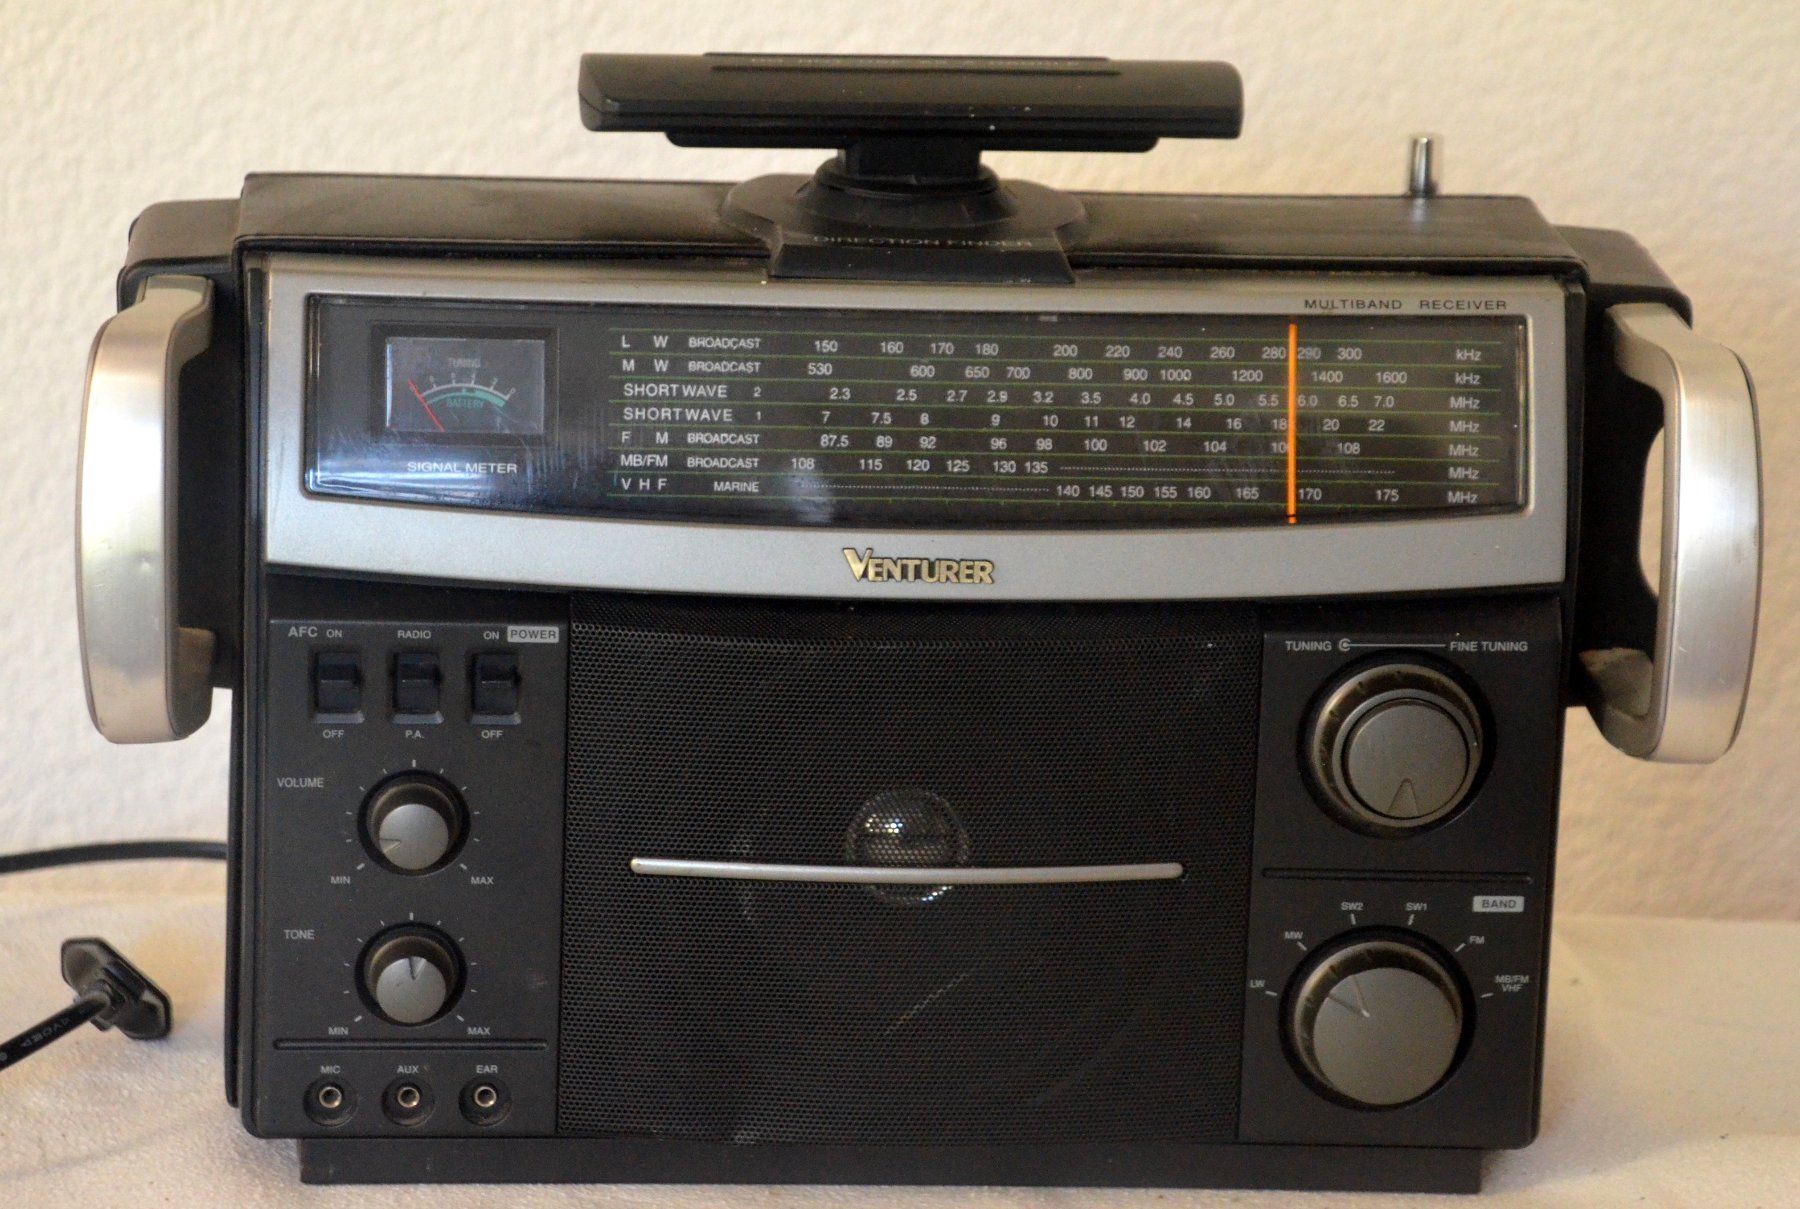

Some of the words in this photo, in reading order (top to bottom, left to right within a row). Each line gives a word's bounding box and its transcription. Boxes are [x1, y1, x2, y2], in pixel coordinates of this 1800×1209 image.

[1304, 299, 1402, 309] MULTIBAND
[1420, 300, 1507, 310] RECEIVER
[688, 337, 761, 349] BROADCAST
[815, 340, 838, 352] 150
[880, 342, 904, 353] 160
[931, 342, 954, 354] 170
[975, 343, 999, 356] 180
[1053, 344, 1078, 357] 200
[1105, 345, 1130, 358] 220
[1157, 346, 1183, 358] 240
[1210, 347, 1235, 359] 260
[1262, 347, 1286, 359] 280
[1337, 348, 1362, 360] 300
[1456, 349, 1482, 361] kHz
[688, 361, 761, 373] BROADCAST
[808, 362, 832, 375] 530
[910, 365, 935, 377] 600
[965, 366, 990, 378] 650
[1006, 366, 1031, 379] 700
[1068, 368, 1093, 380] 800
[1123, 368, 1148, 381] 900
[1160, 369, 1192, 381] 1000
[1232, 370, 1263, 382] 1200
[1311, 371, 1343, 383] 1400
[1376, 371, 1407, 384] 1600
[1455, 372, 1480, 385] kHz
[753, 387, 762, 397] 2
[830, 387, 851, 400] 2.3
[896, 389, 917, 401] 2.5
[947, 390, 968, 402] 2.7
[1032, 391, 1054, 403] 3.2
[1081, 392, 1101, 404] 3.5
[1130, 393, 1151, 405] 4.0
[1173, 393, 1194, 405] 4.5
[1214, 394, 1235, 406] 5.0
[1258, 394, 1279, 406] 5.5
[1338, 395, 1359, 407] 6.5
[1374, 396, 1394, 407] 7.0
[1450, 396, 1480, 409] MHz
[822, 411, 831, 424] 7
[871, 412, 892, 424] 7.5
[991, 414, 1001, 426] 9
[1043, 415, 1059, 427] 10
[1084, 416, 1099, 427] 11
[1119, 416, 1135, 428] 12
[1176, 417, 1192, 429] 14
[1226, 418, 1242, 430] 16
[1323, 419, 1340, 431] 20
[1368, 419, 1385, 431] 22
[1450, 421, 1480, 433] MHz
[687, 433, 760, 445] BROADCAST
[820, 434, 849, 447] 87.5
[876, 435, 893, 448] 89
[919, 436, 936, 449] 92
[990, 438, 1007, 450] 96
[1036, 438, 1052, 450] 98
[1084, 439, 1108, 451] 100
[1143, 440, 1167, 452] 102
[1203, 441, 1227, 452] 104
[1271, 441, 1290, 453] 10
[1336, 442, 1360, 454] 108
[1449, 444, 1479, 457] MHz
[407, 461, 461, 472] SIGNAL
[465, 463, 517, 473] METER
[621, 454, 668, 467] MB/FM
[687, 457, 760, 469] BROADCAST
[792, 458, 815, 470] 108
[860, 459, 883, 471] 115
[906, 459, 930, 471] 120
[946, 460, 970, 472] 125
[993, 460, 1016, 473] 130
[1024, 461, 1048, 473] 135
[1448, 467, 1479, 480] MHz
[714, 481, 759, 493] MARINE
[1056, 485, 1080, 497] 140
[1089, 485, 1113, 498] 145
[1120, 486, 1144, 498] 150
[1153, 486, 1178, 498] 155
[1187, 486, 1211, 499] 160
[1235, 487, 1259, 499] 165
[1298, 488, 1322, 500] 170
[1375, 489, 1399, 501] 175
[1448, 491, 1478, 504] MHz
[843, 547, 995, 584] VENTURER
[288, 626, 318, 638] AFC
[326, 629, 342, 638] ON
[397, 630, 431, 639] RADIO
[483, 631, 500, 640] ON
[510, 629, 557, 639] POWER
[1285, 641, 1332, 651] TUNING
[1450, 641, 1478, 651] FINE
[1481, 641, 1528, 651] TUNING
[322, 730, 345, 739] OFF
[481, 730, 503, 739] OFF
[277, 778, 324, 788] VOLUME
[331, 876, 350, 885] MIN
[471, 877, 494, 885] MAX
[1341, 902, 1363, 911] SW2
[1406, 902, 1427, 911] SW1
[1482, 899, 1516, 909] BAND
[284, 930, 315, 940] TONE
[1285, 931, 1303, 940] MW
[1470, 936, 1485, 945] FM
[1250, 979, 1265, 988] LW
[1495, 975, 1529, 983] MB/FM
[1501, 984, 1523, 992] VHF
[328, 1027, 349, 1036] MIN
[467, 1027, 491, 1035] MAX
[321, 1065, 341, 1074] MIC
[397, 1065, 419, 1074] AUX
[476, 1065, 498, 1074] EAR
